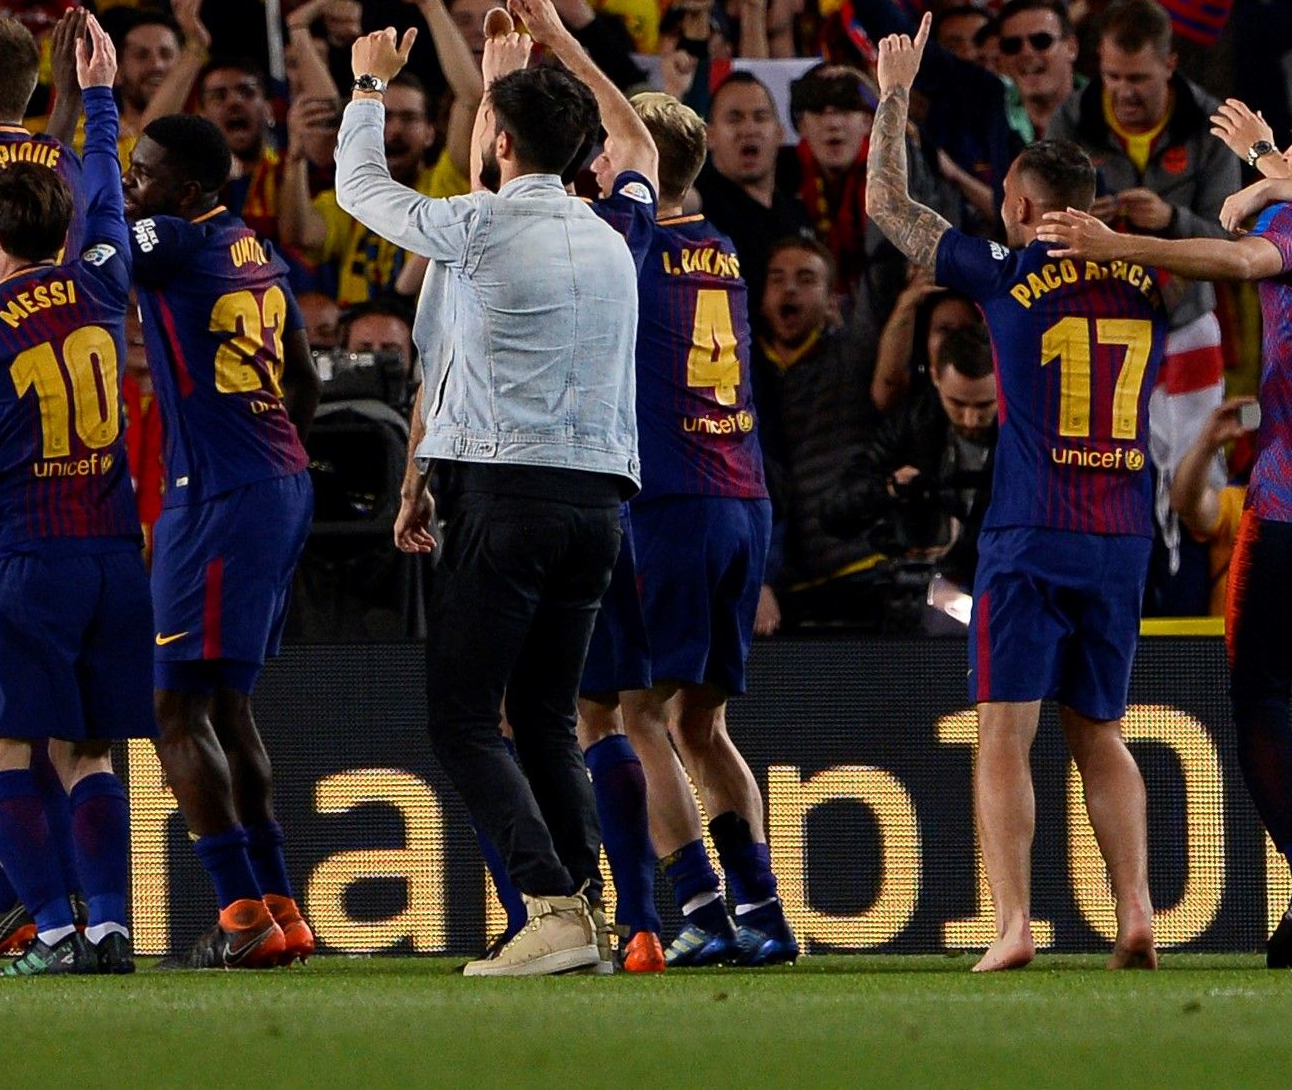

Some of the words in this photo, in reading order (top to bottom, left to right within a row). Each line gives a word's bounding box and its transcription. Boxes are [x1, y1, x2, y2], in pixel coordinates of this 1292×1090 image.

[1009, 259, 1079, 309] PACO
[686, 289, 741, 406] 4
[9, 324, 119, 459] 10
[1040, 316, 1153, 441] 17
[683, 414, 736, 436] unicef
[33, 452, 98, 479] unicef
[1051, 446, 1123, 470] unicef
